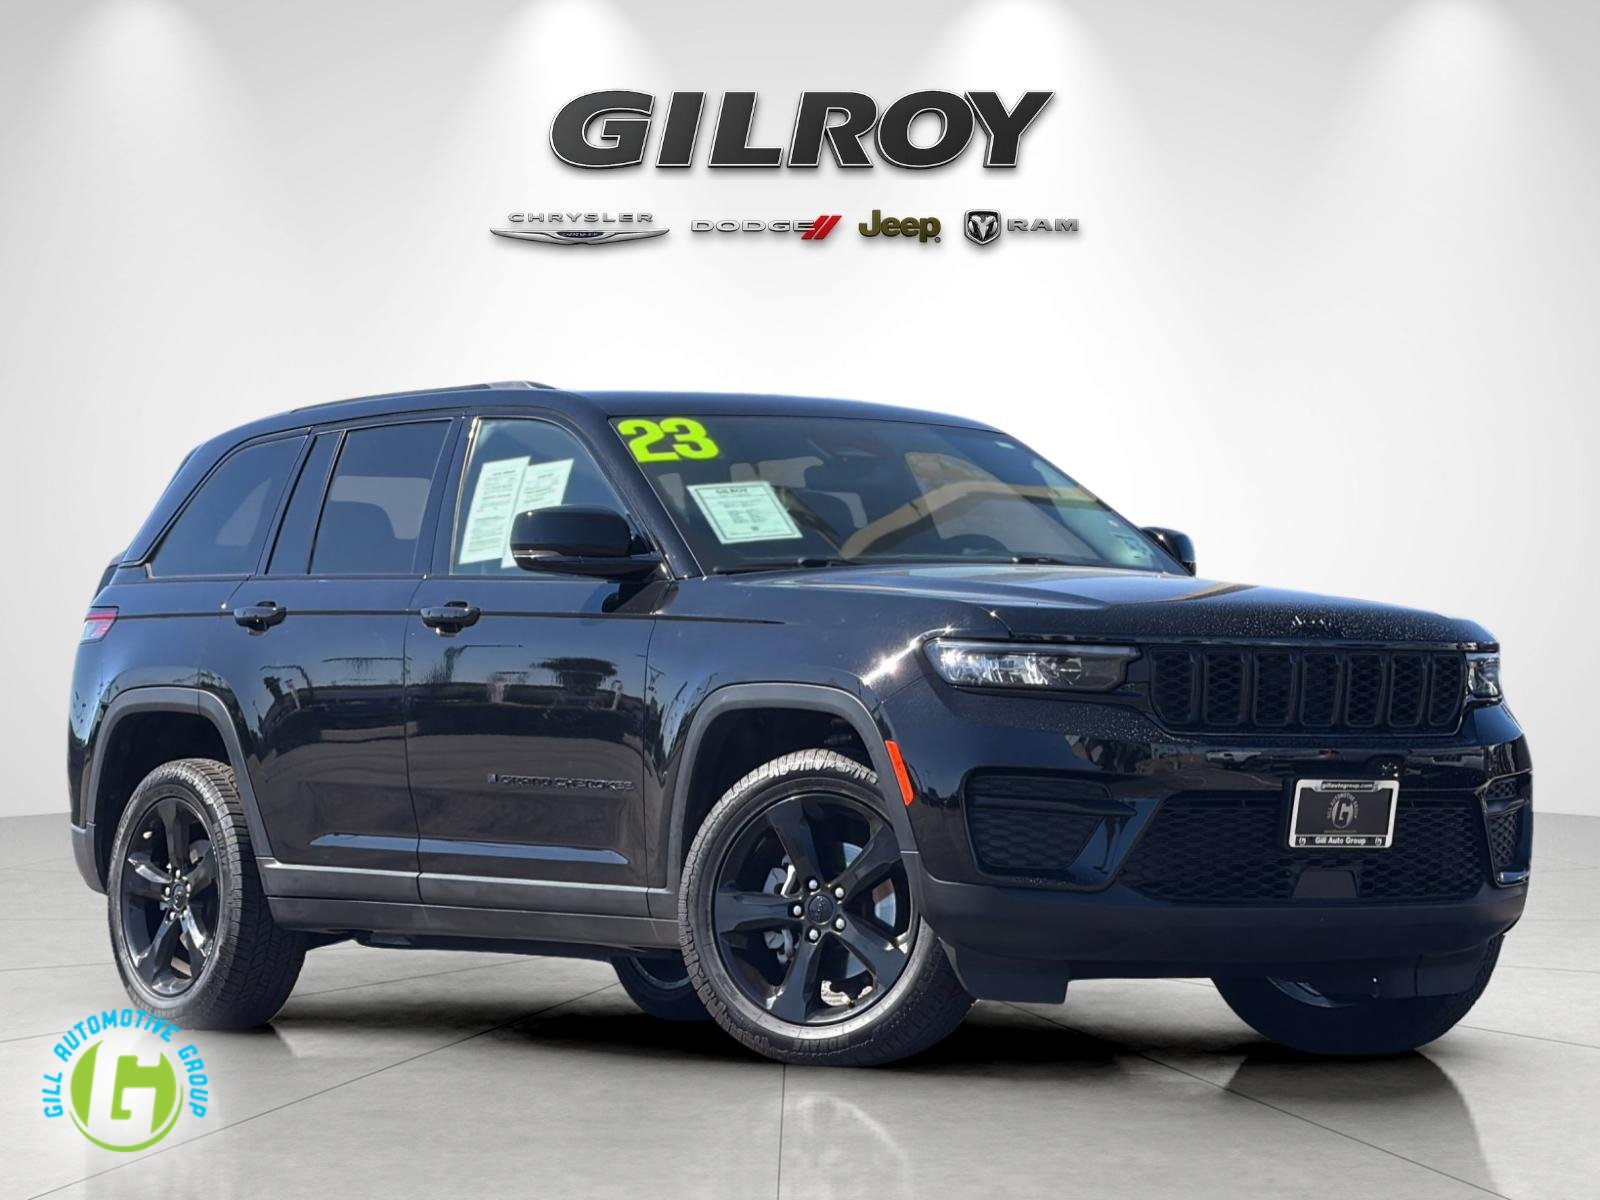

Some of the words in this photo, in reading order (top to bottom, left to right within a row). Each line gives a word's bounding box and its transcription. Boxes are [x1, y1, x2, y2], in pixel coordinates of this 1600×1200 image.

[617, 417, 720, 463] 23
[1314, 836, 1327, 844] Gill
[1328, 836, 1344, 844] Auto
[1345, 836, 1367, 845] Group
